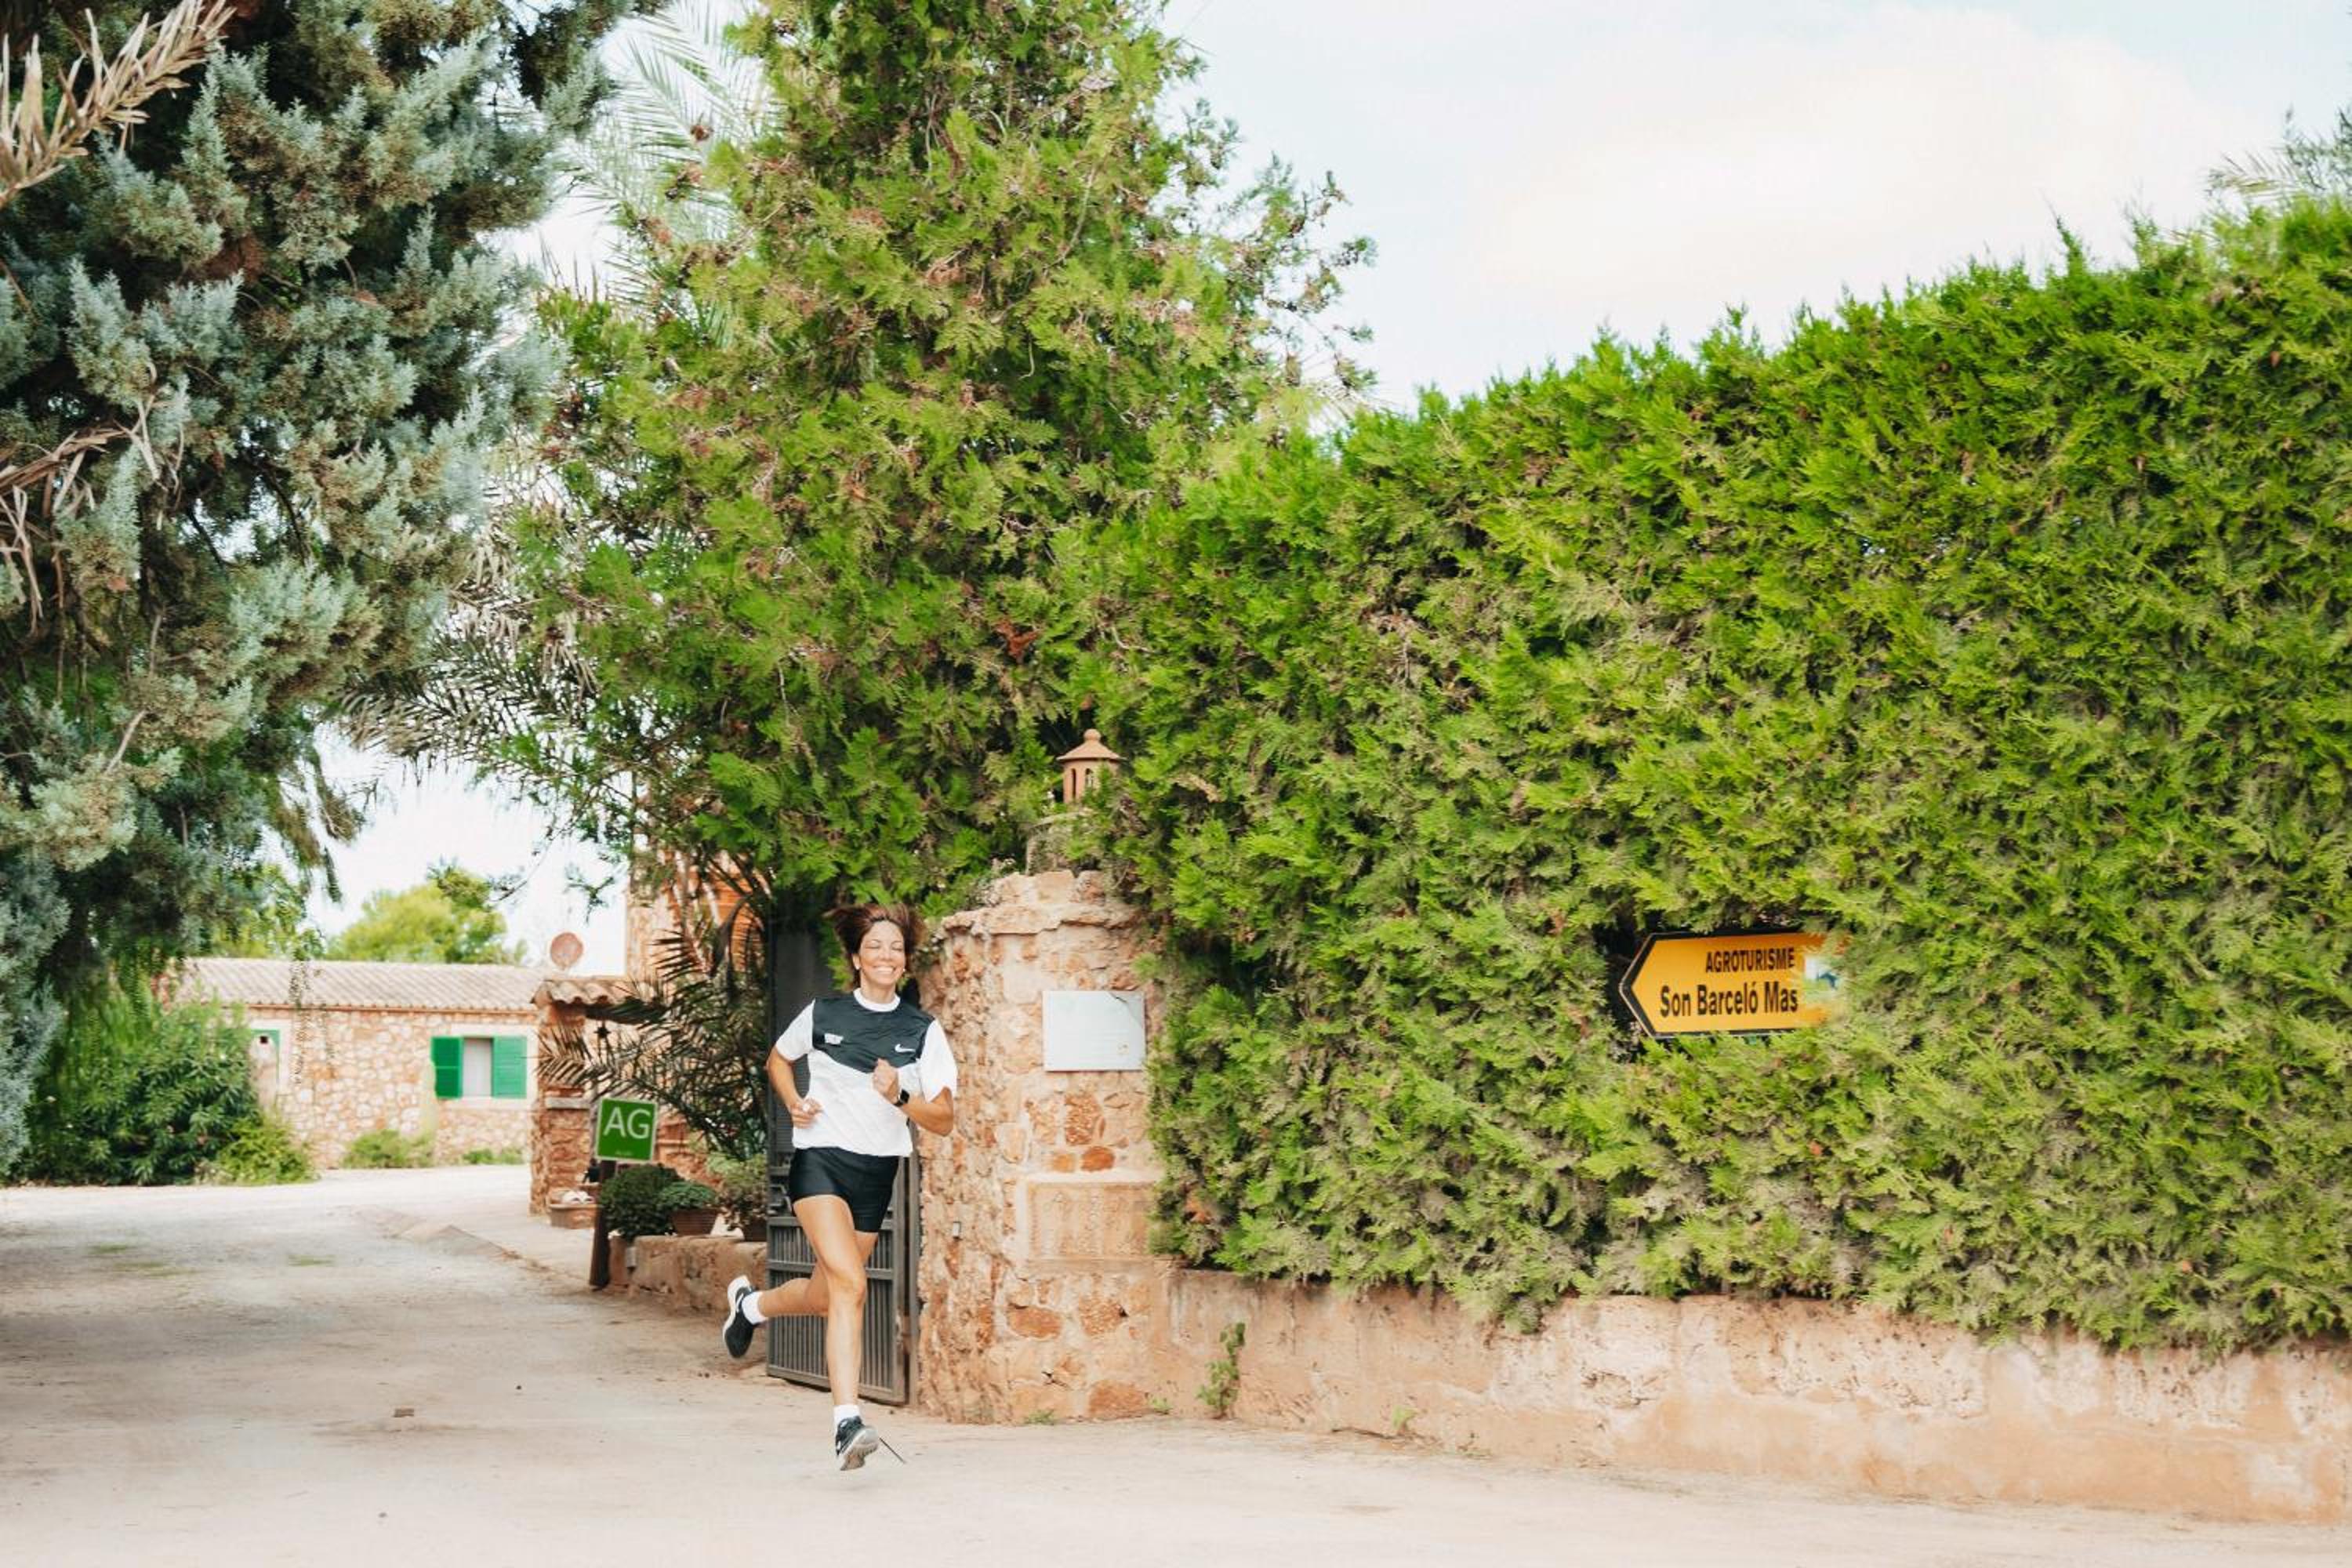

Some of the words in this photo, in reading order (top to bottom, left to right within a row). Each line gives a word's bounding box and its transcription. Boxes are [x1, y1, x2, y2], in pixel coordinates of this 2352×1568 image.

[1705, 947, 1795, 973] AGROTURISME
[1660, 985, 1691, 1018] Son
[1697, 982, 1759, 1015] Barceló
[1764, 981, 1798, 1013] Mas
[603, 1106, 651, 1139] AG
